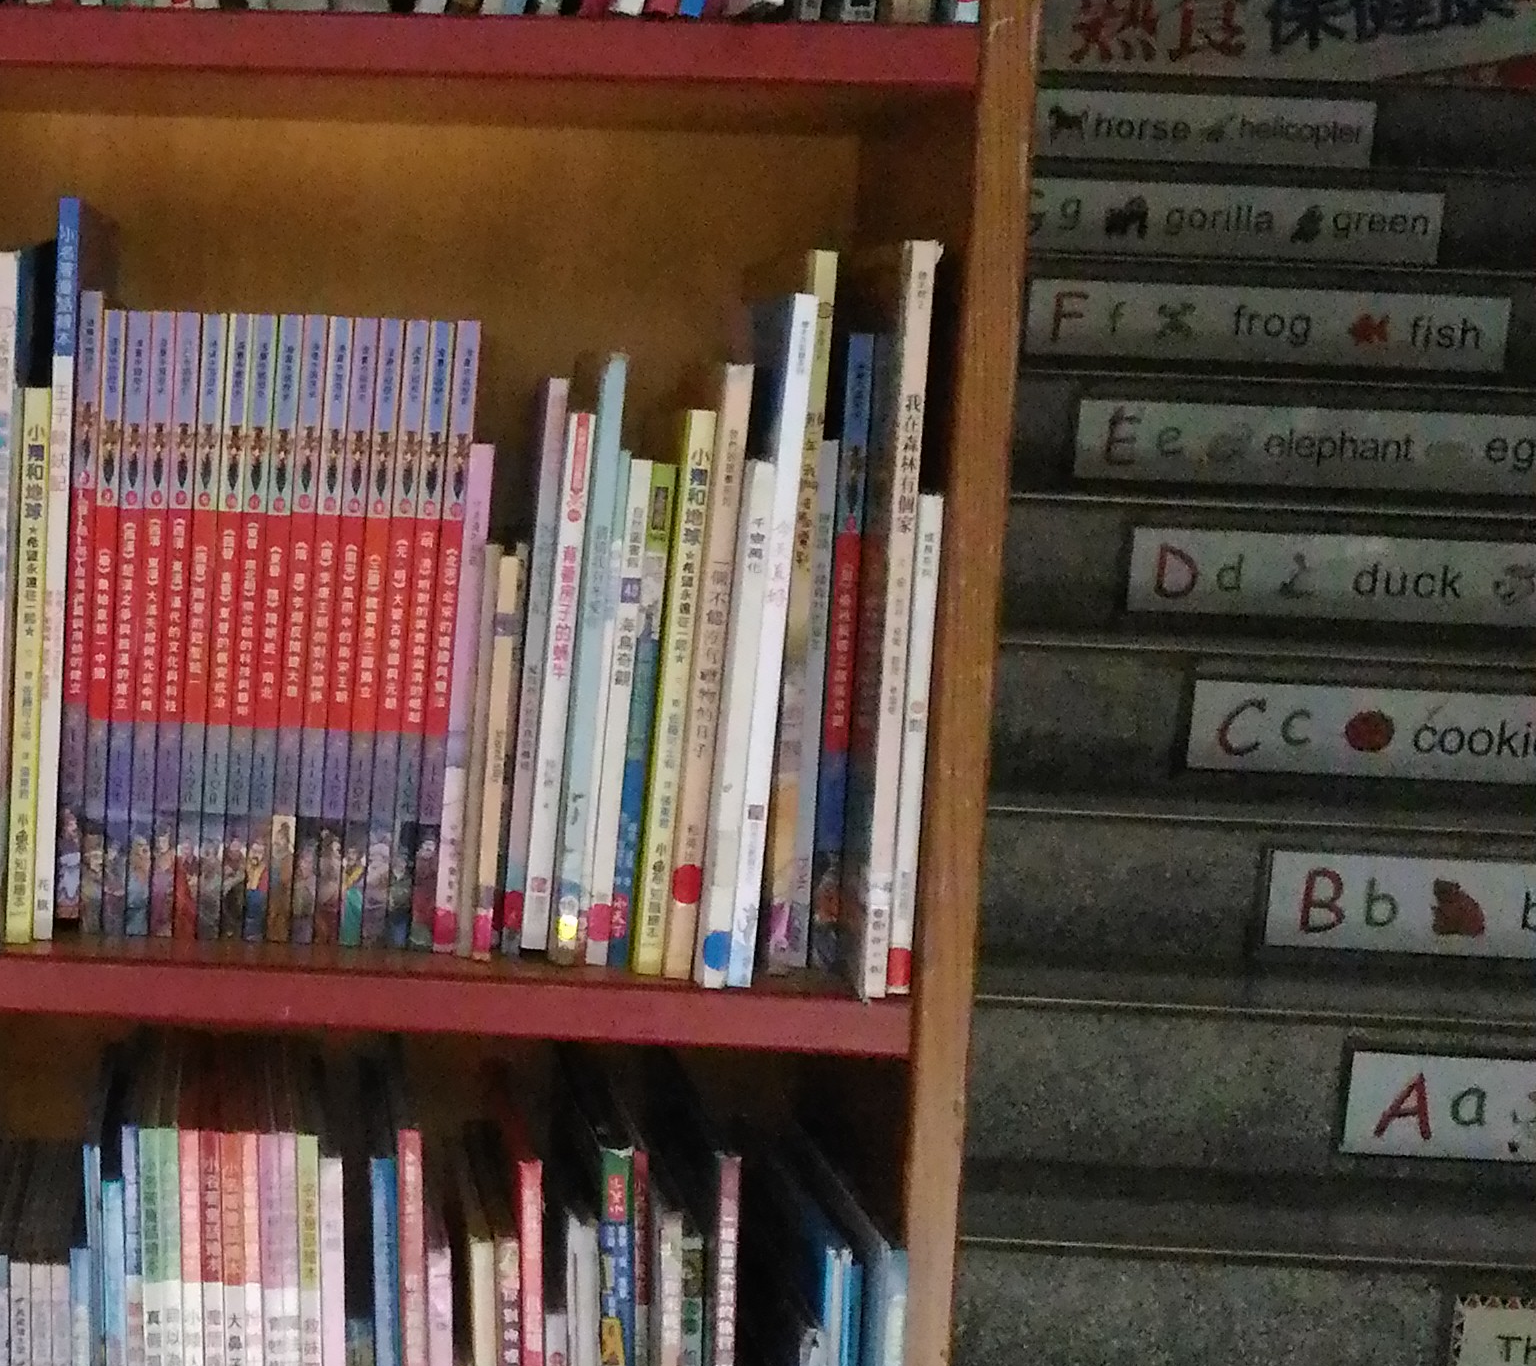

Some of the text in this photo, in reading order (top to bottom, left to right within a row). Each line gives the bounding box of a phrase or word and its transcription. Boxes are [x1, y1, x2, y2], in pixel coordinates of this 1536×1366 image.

[1094, 110, 1364, 146] horse helicopter
[1165, 202, 1274, 240] gorilla
[1331, 206, 1431, 242] green
[1049, 290, 1091, 341] F
[1232, 303, 1313, 346] frog
[1410, 314, 1483, 351] fish
[894, 392, 922, 536] 我在森林有個家
[1103, 404, 1142, 465] E
[1156, 424, 1183, 459] e
[1264, 426, 1415, 466] elephant
[1155, 545, 1463, 599] D d duck
[1217, 696, 1268, 758] C
[1281, 709, 1314, 747] c
[1298, 867, 1400, 935] B b
[1374, 1071, 1485, 1141] A a
